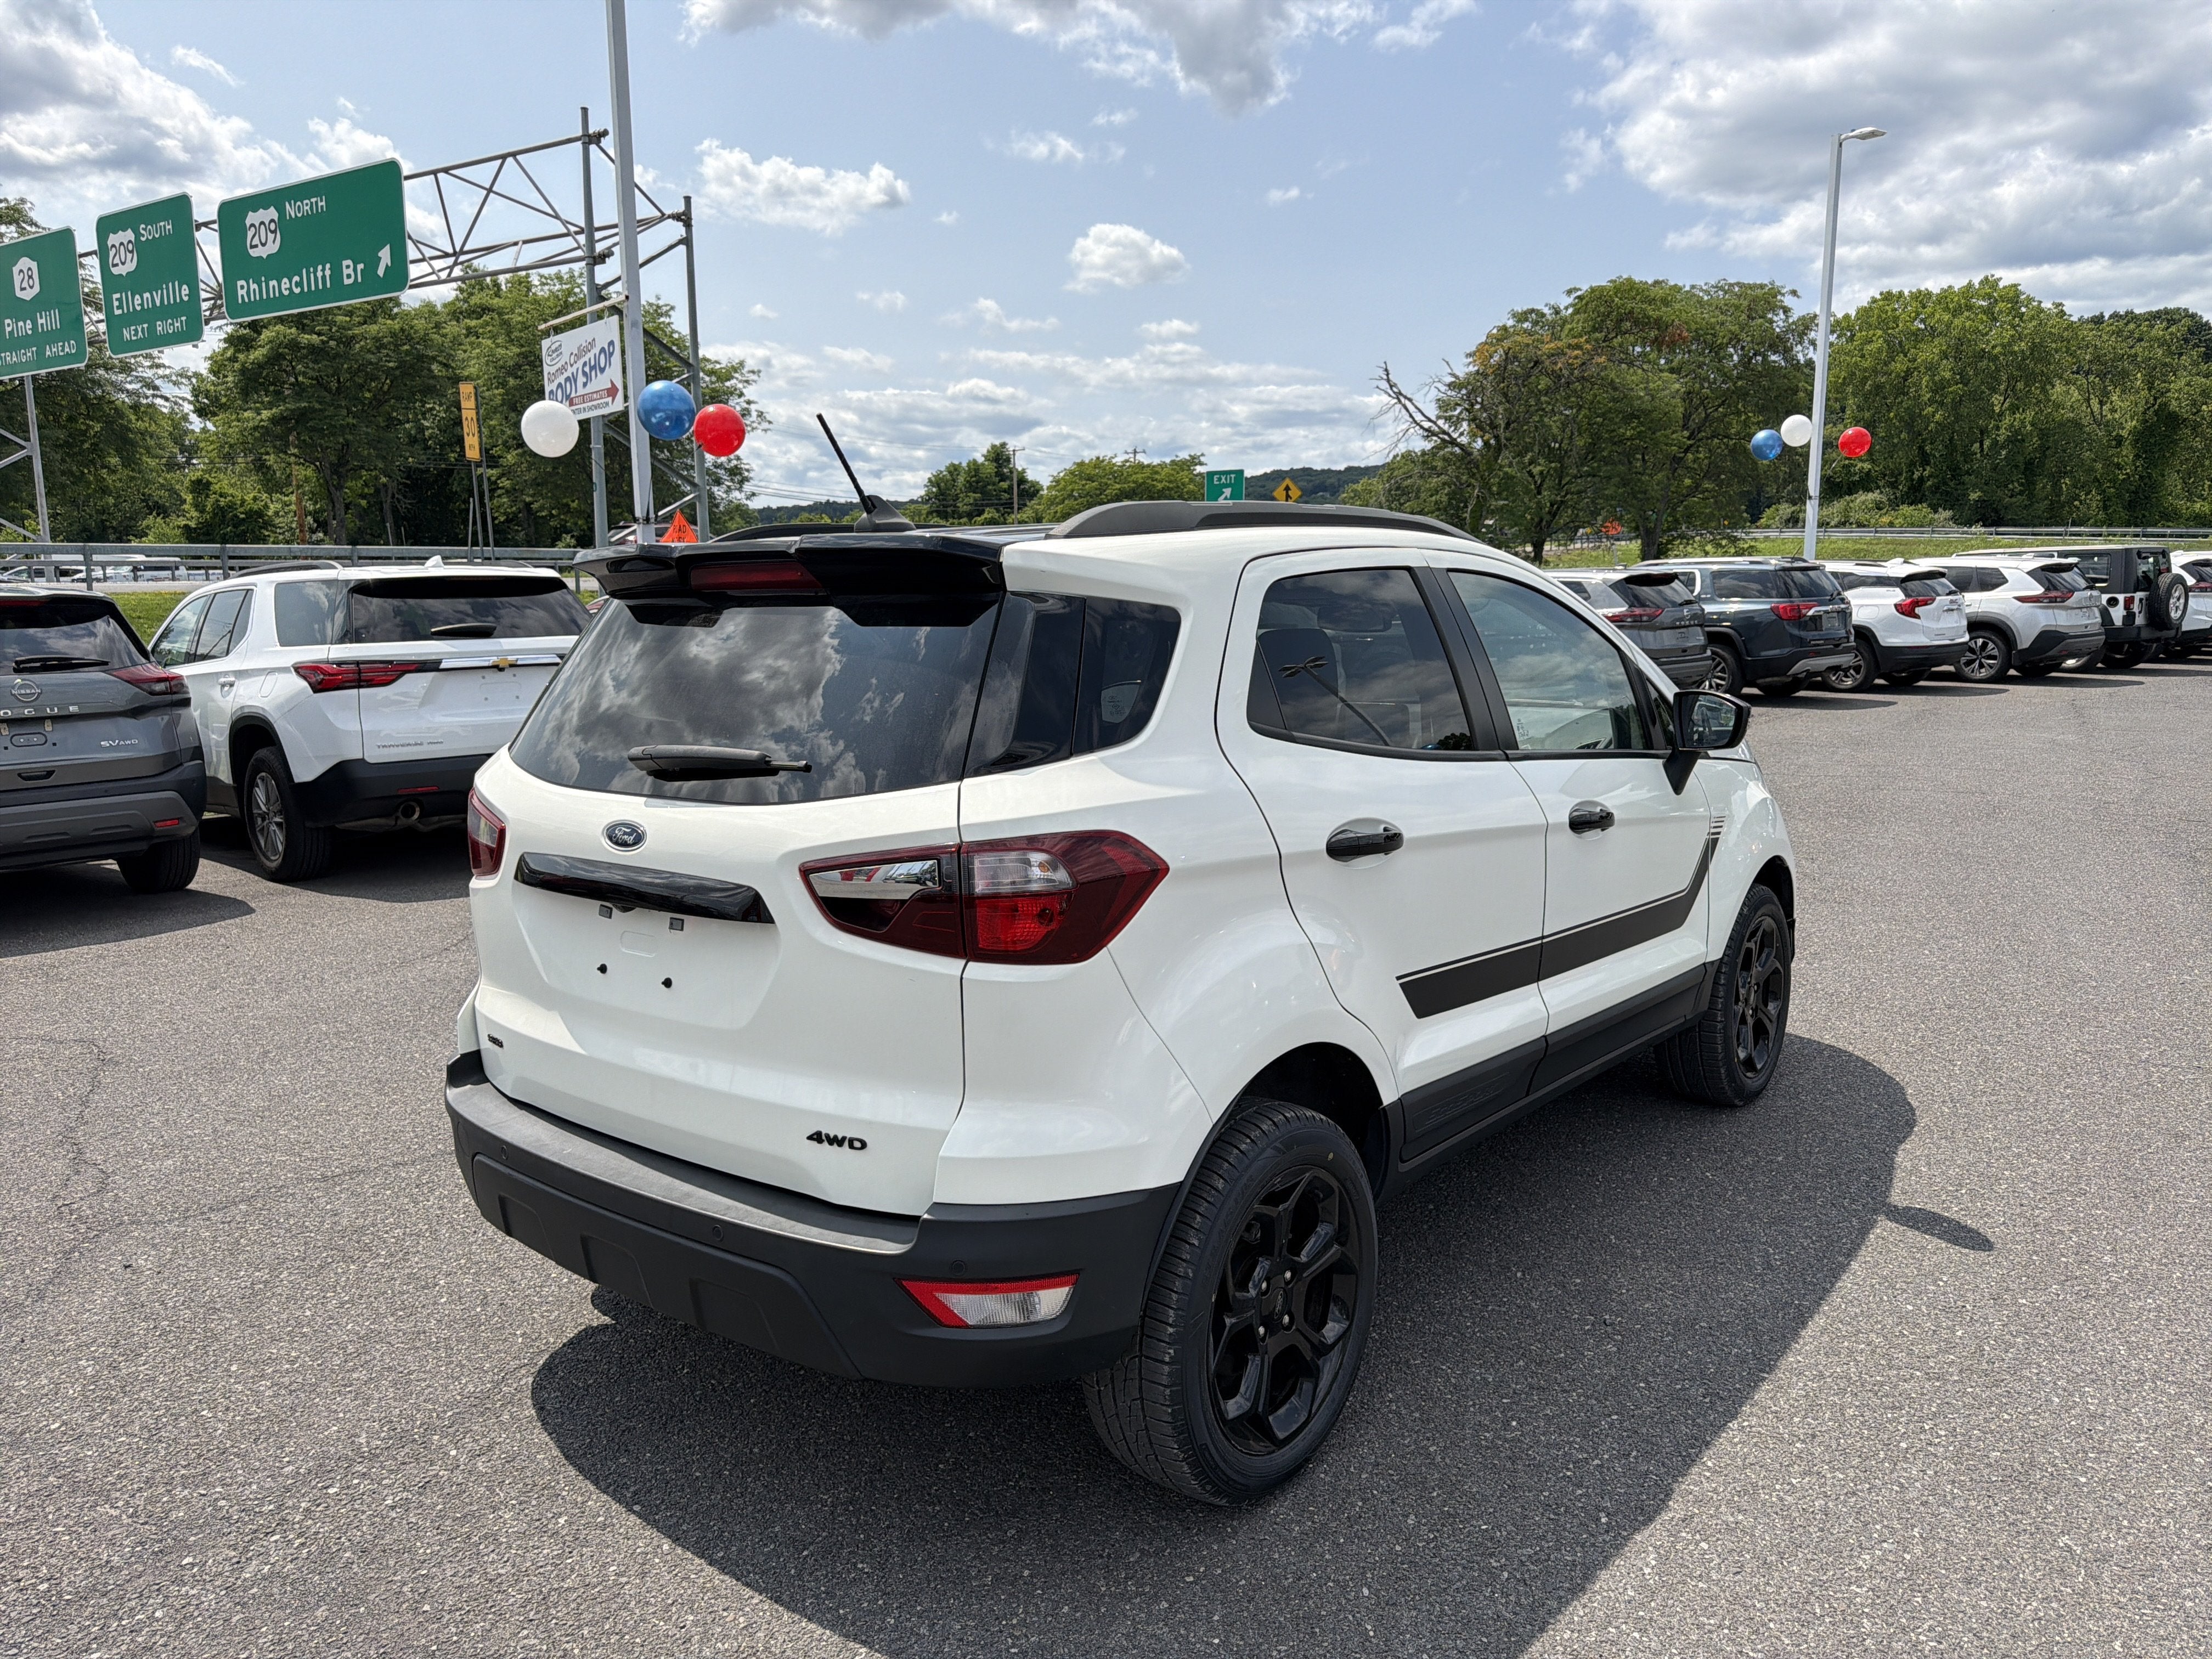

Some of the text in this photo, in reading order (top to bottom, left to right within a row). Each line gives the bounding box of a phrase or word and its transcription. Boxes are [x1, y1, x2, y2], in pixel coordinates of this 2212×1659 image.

[285, 195, 326, 220] NORTH
[139, 219, 173, 241] SOUTH
[248, 218, 278, 250] 209
[110, 239, 134, 268] 209
[18, 267, 35, 291] 28
[236, 259, 364, 303] Rhinecliff Br
[112, 280, 189, 316] Ellenville
[4, 308, 60, 339] Pine Hill
[123, 316, 187, 342] NEXT RIGHT
[0, 340, 76, 366] TRAIGHT AHEAD
[547, 337, 596, 386] Romeo Collision
[582, 339, 615, 389] SHOP
[573, 390, 607, 405] FREE ESTIMATES
[587, 400, 610, 413] SHOWROOM
[465, 416, 475, 437] 30
[1214, 474, 1236, 484] EXIT
[612, 827, 636, 844] Ford
[806, 1130, 867, 1150] 4WD
